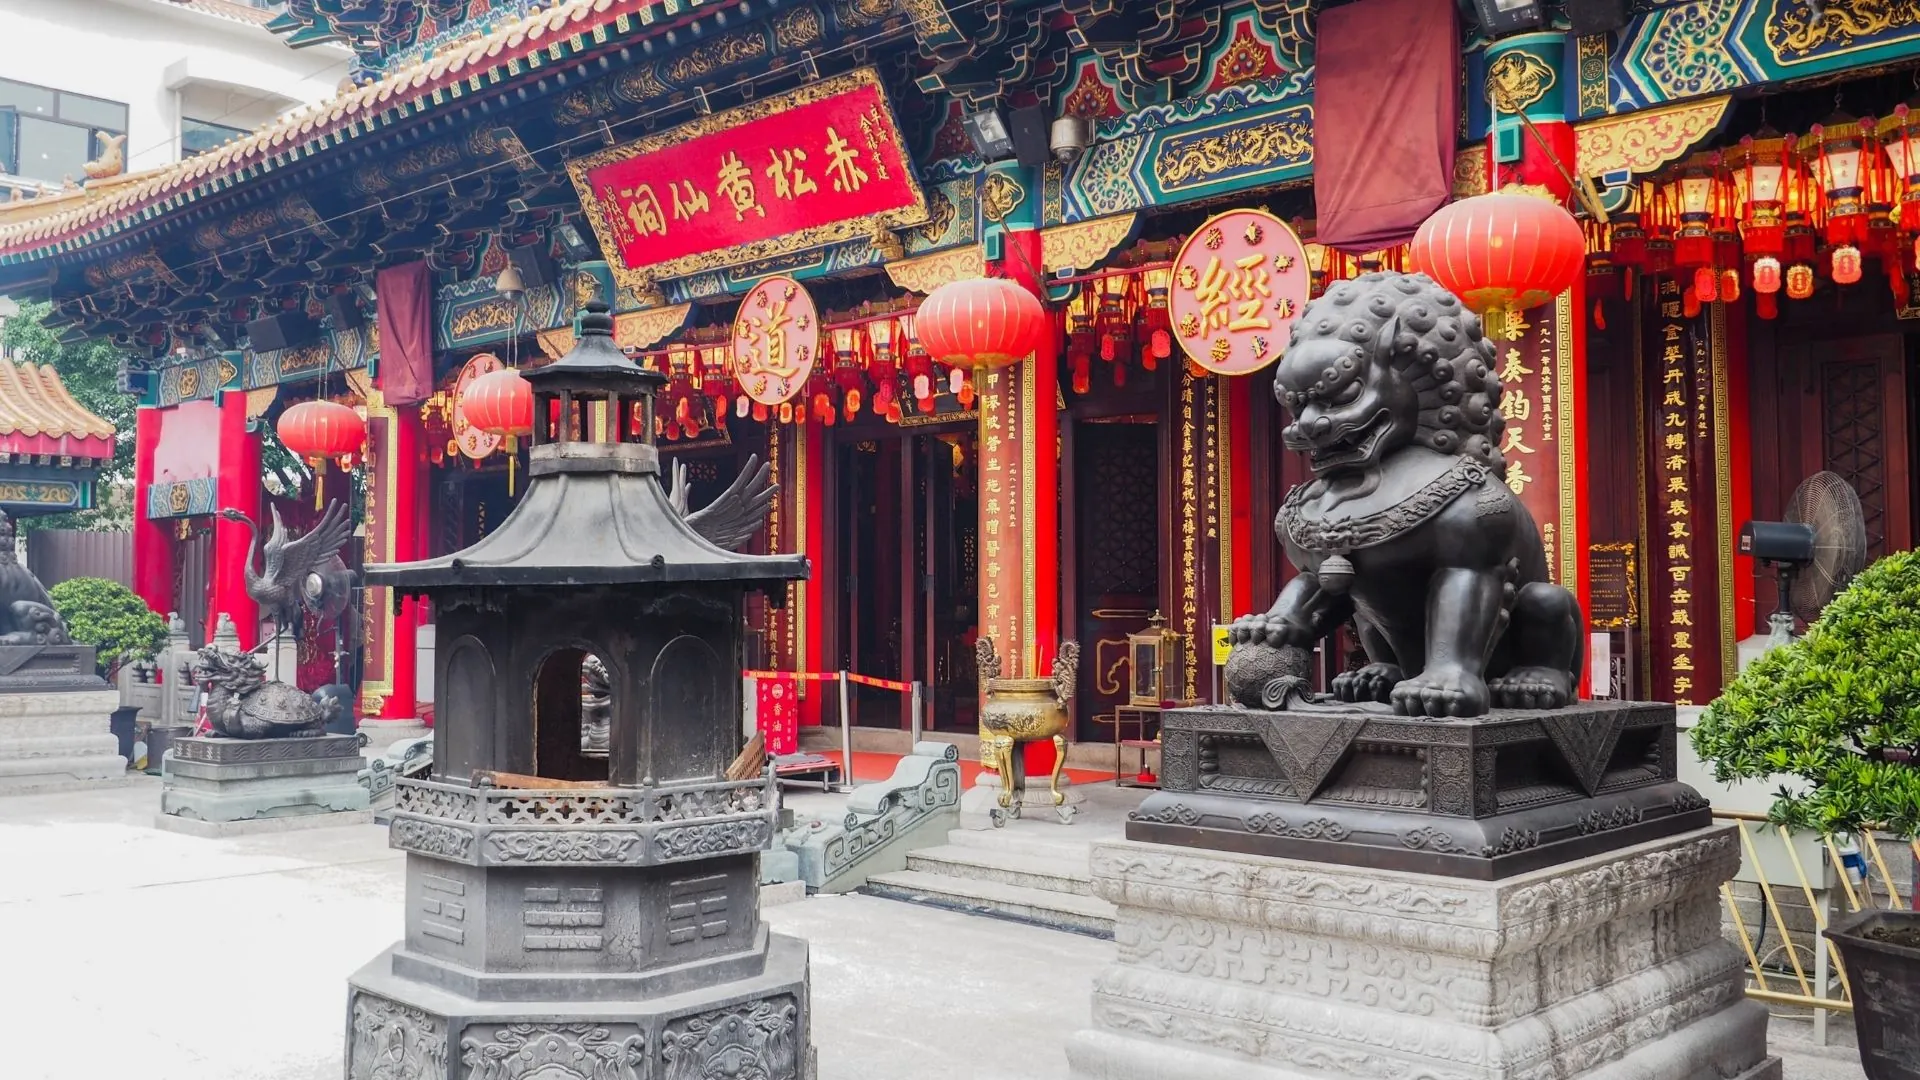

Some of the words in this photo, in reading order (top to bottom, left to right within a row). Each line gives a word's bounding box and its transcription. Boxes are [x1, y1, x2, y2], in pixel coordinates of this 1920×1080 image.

[1194, 253, 1272, 340] 經
[749, 300, 800, 377] 道
[772, 702, 783, 750] 香油箱
